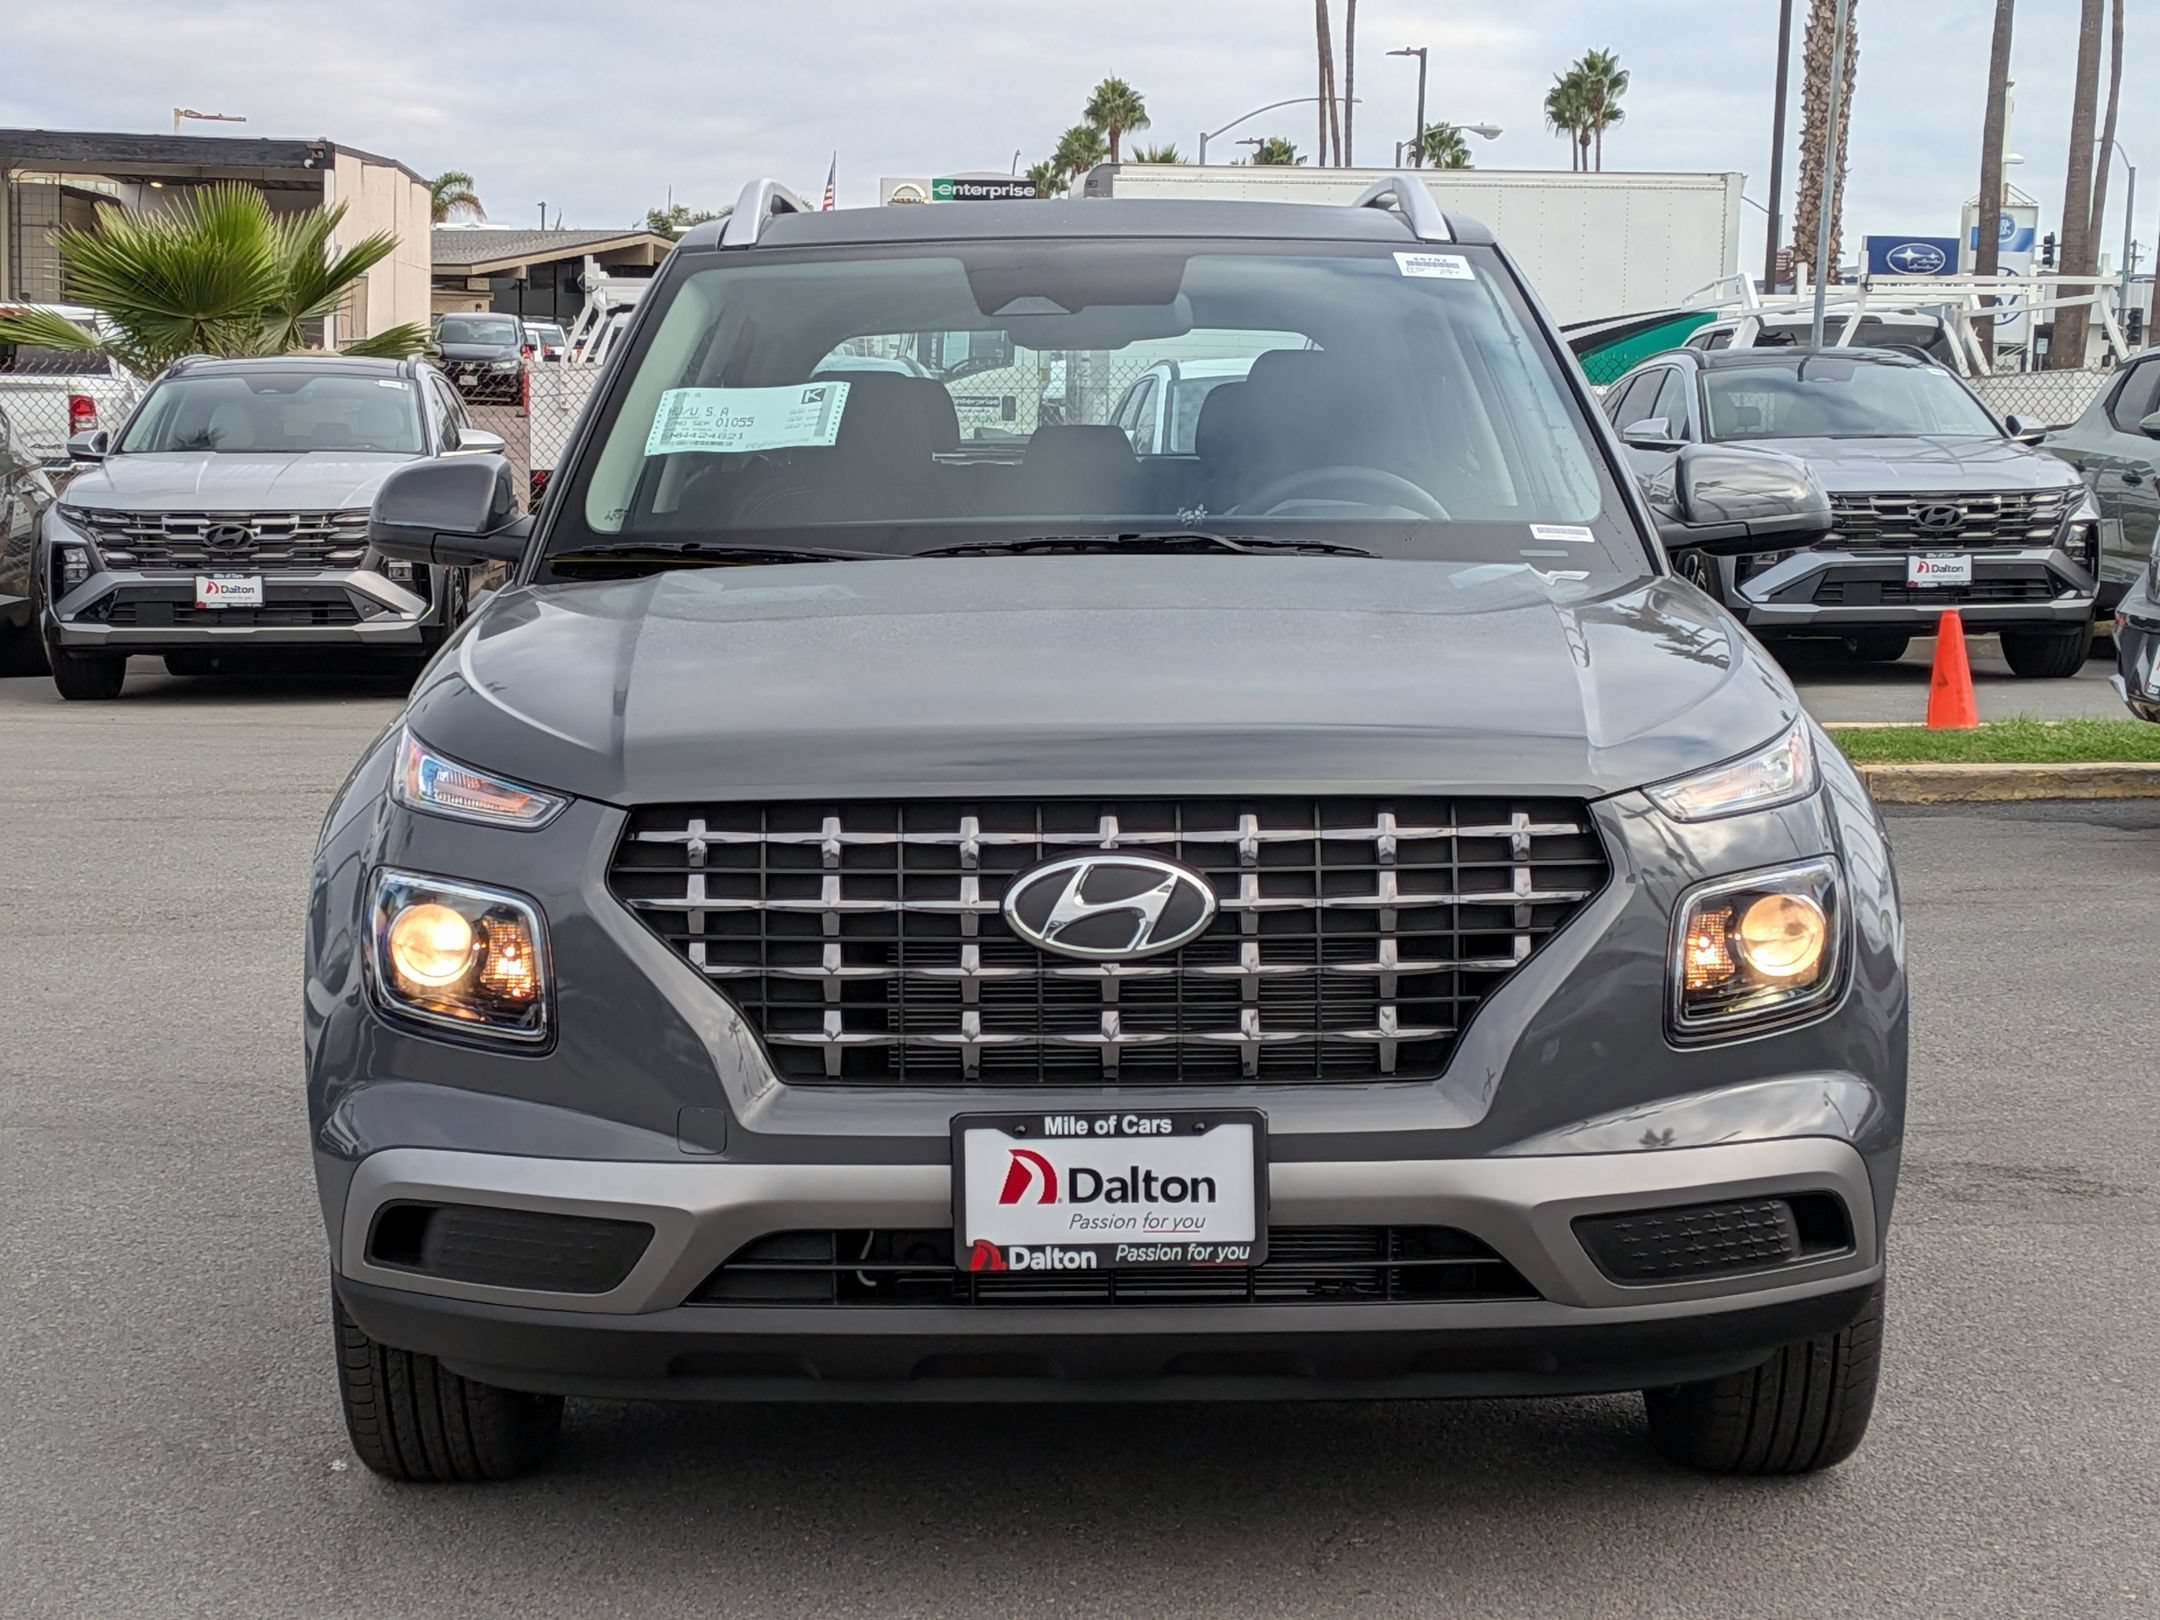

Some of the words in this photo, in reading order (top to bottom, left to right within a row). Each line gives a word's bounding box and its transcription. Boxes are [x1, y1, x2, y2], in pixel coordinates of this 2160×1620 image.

[937, 184, 1036, 200] enterprise
[715, 416, 755, 429] 01055
[1931, 563, 1964, 573] Dalton
[220, 584, 255, 594] Dalton
[1044, 1116, 1089, 1136] Mile
[1094, 1115, 1118, 1135] of
[1122, 1115, 1173, 1134] Cars
[1068, 1165, 1217, 1204] Dalton
[1068, 1212, 1137, 1230] Passion
[1142, 1211, 1169, 1230] for
[1171, 1215, 1206, 1232] you
[1008, 1246, 1098, 1271] Dalton
[1115, 1244, 1182, 1263] Passion
[1187, 1243, 1214, 1262] for
[1214, 1245, 1251, 1264] you
